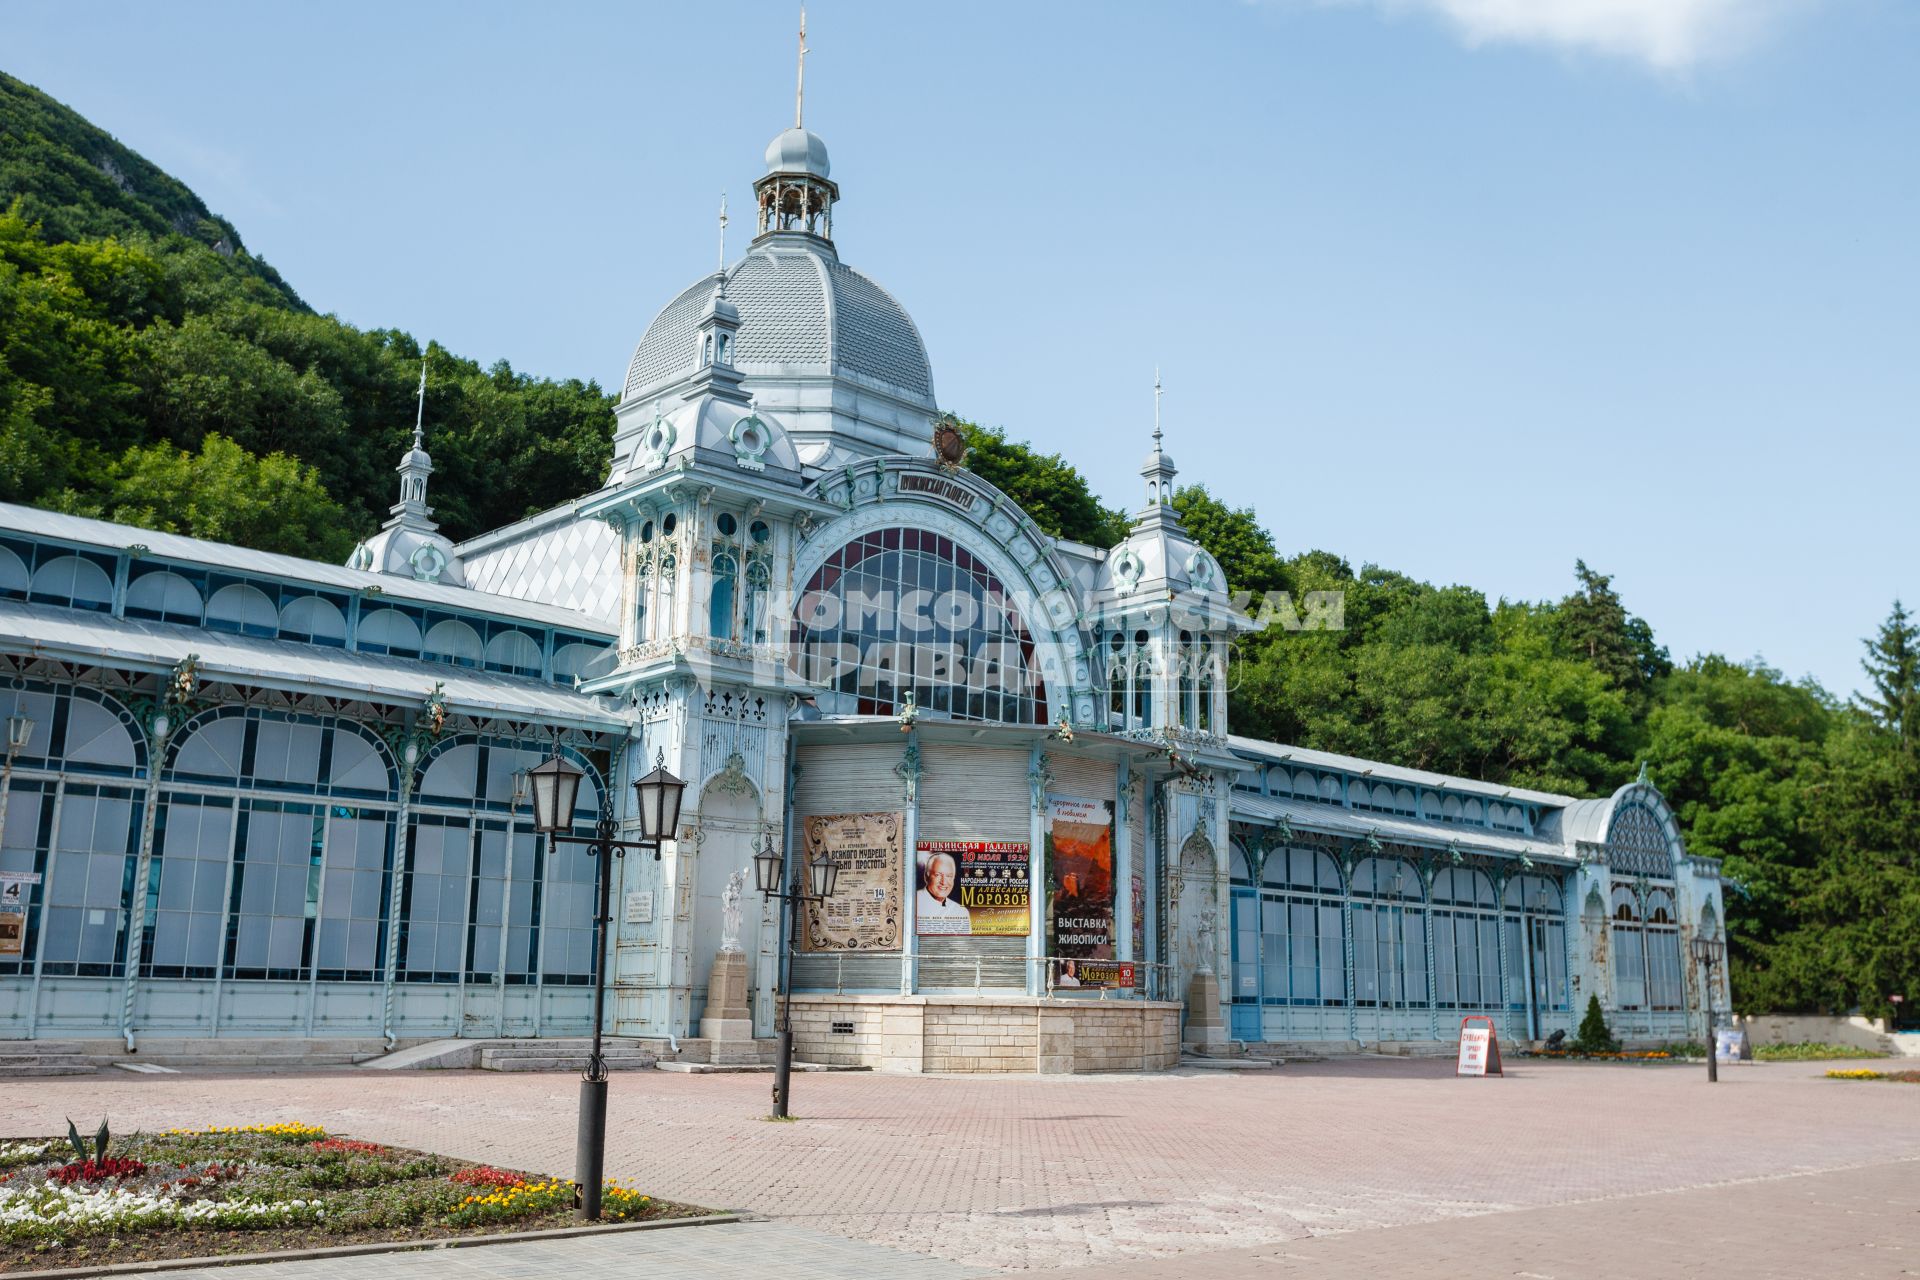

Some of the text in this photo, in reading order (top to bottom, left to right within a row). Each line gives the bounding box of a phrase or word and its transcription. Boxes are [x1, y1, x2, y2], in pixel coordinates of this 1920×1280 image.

[918, 842, 1029, 850] ПУШКИНСКАЯ ГАЛЛЕРЕЯ
[832, 848, 886, 860] ВСЯКОГО МУДРЕЦА
[962, 852, 976, 862] 10
[977, 853, 1002, 862] ИЮЛЯ
[856, 860, 886, 870] ПРОСТОТЫ
[6, 882, 19, 896] 4
[874, 888, 884, 898] 14
[1058, 918, 1107, 928] ВЫСТАВКА
[1058, 934, 1107, 944] ЖИВОПИСИ
